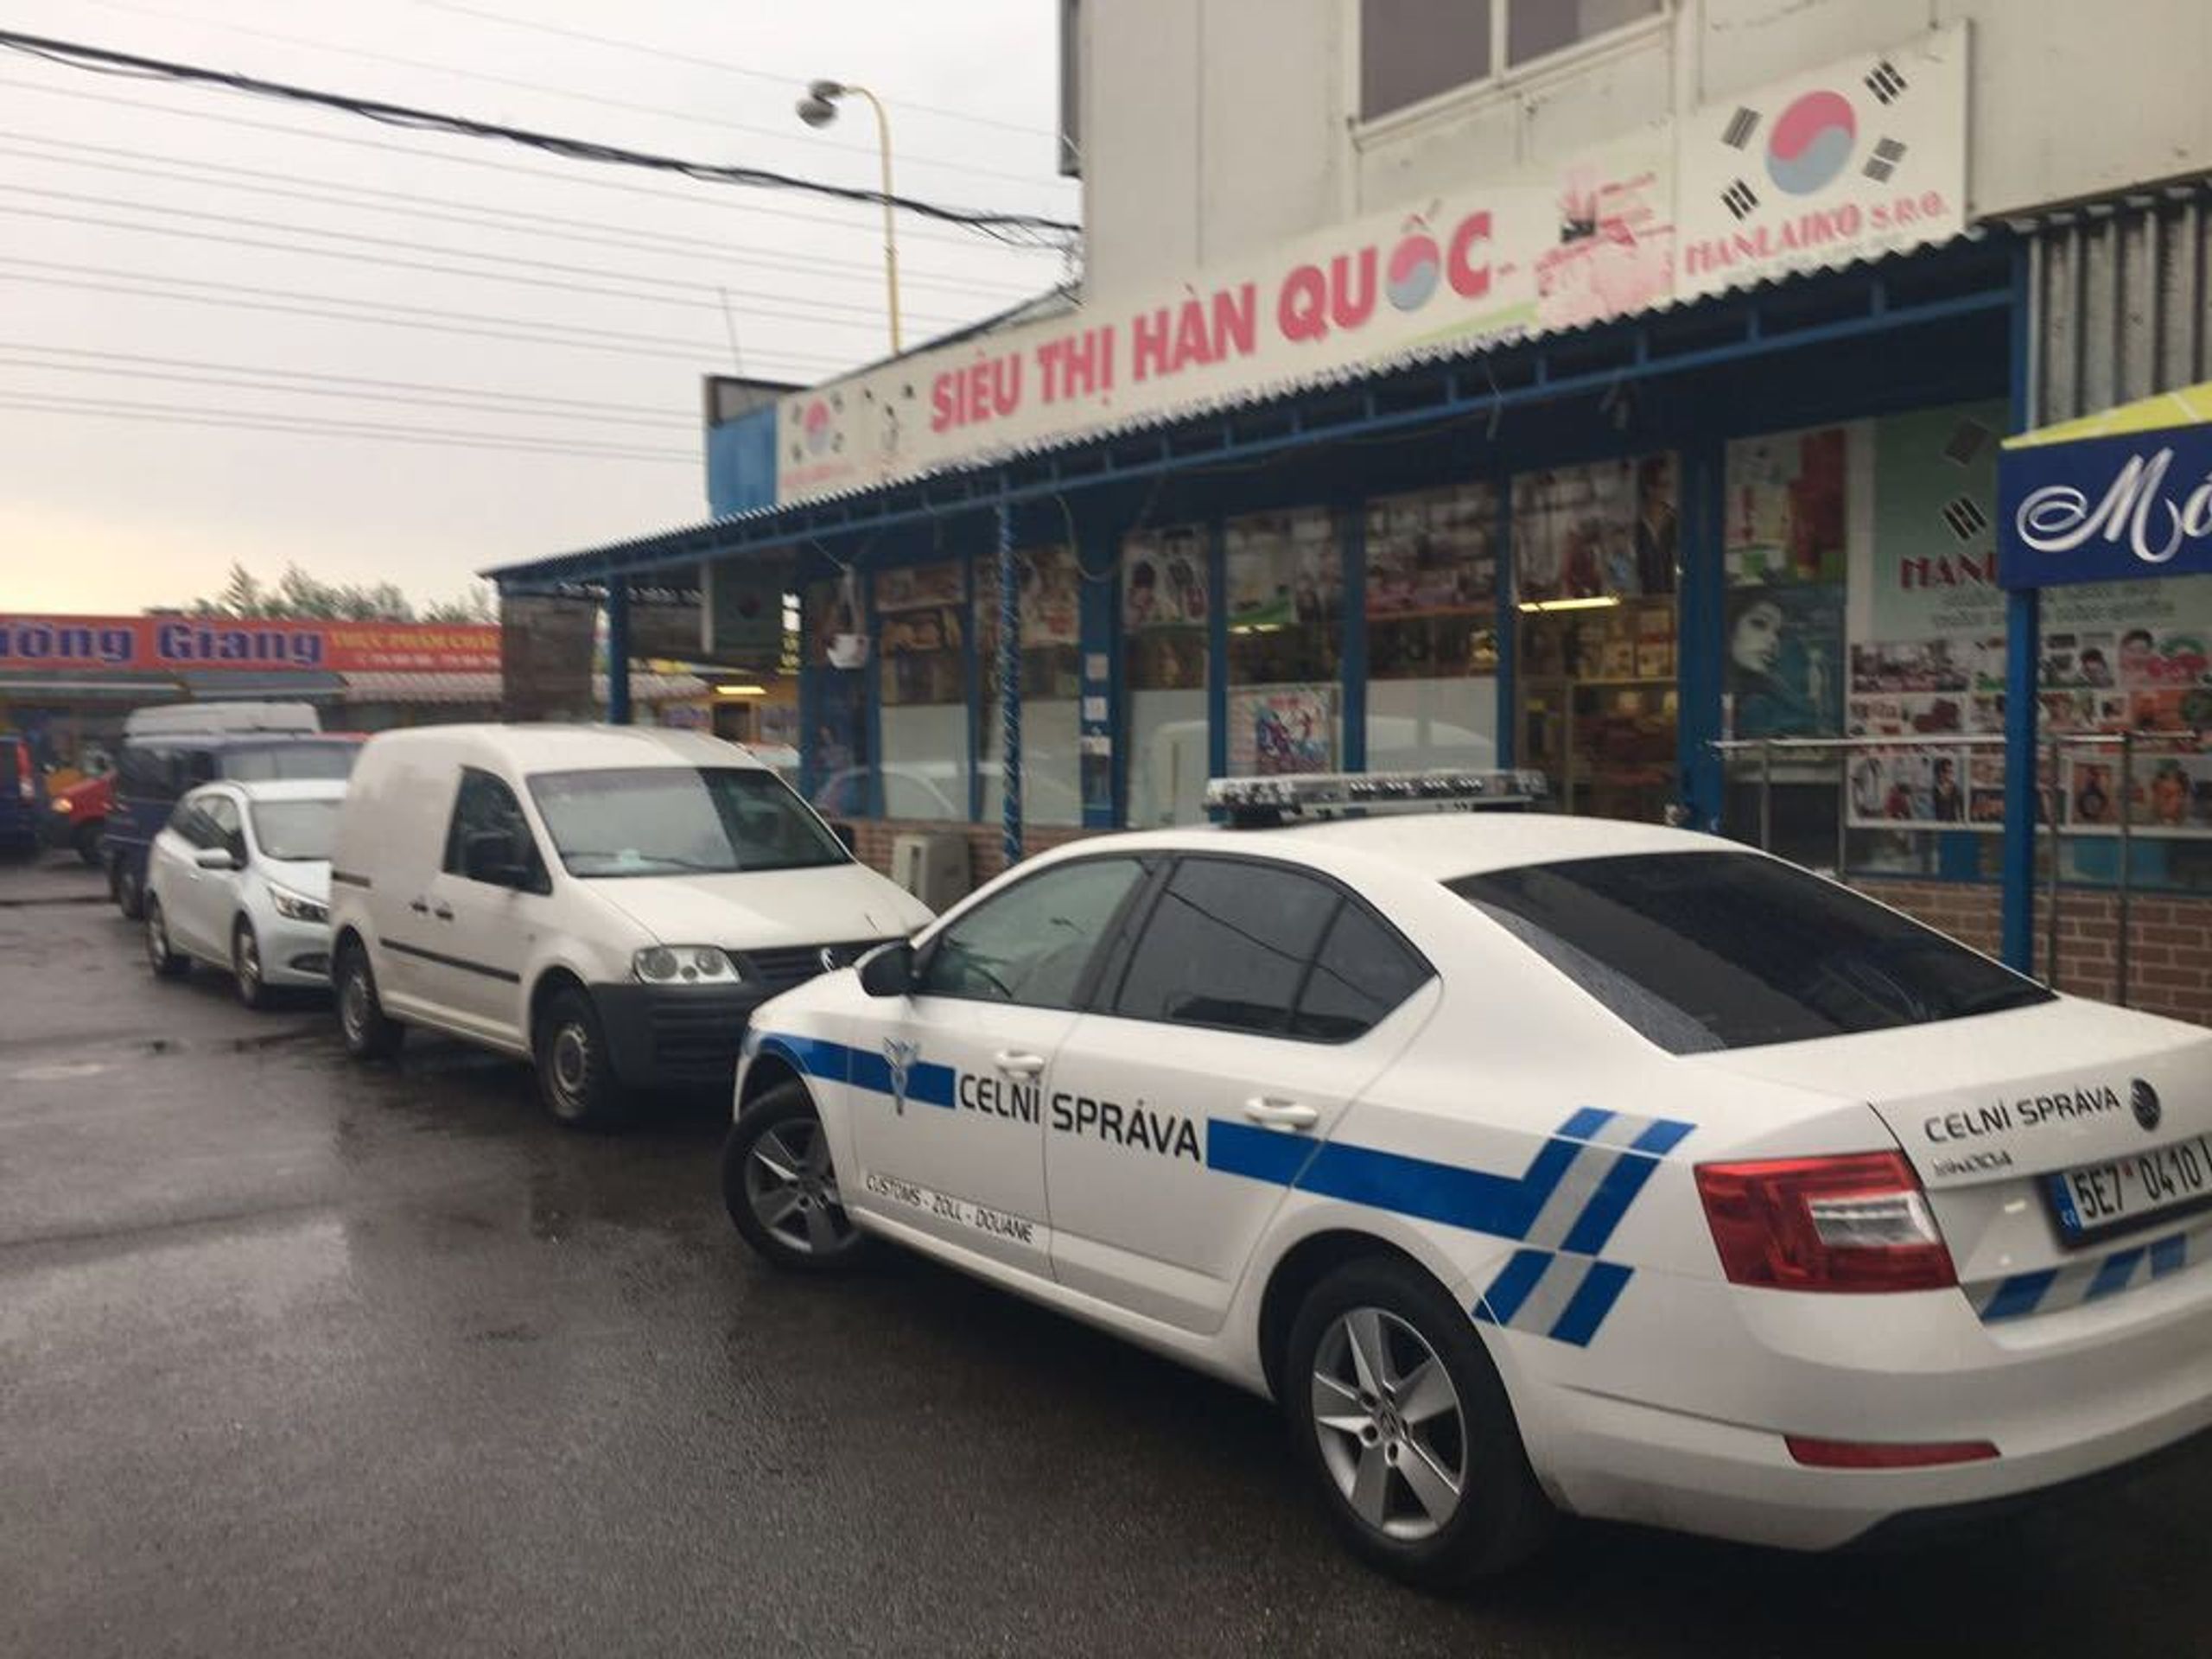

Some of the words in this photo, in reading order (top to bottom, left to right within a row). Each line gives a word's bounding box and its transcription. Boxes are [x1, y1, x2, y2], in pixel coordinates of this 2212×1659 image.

[1038, 324, 1116, 406] THỊ
[1132, 283, 1257, 382] HÀN
[158, 622, 322, 666] Giang
[1051, 1091, 1201, 1162] SPRÁVA
[1923, 1098, 2012, 1143] CELNÍ
[2016, 1085, 2121, 1126] SPRÁVA
[2071, 1166, 2123, 1219] 5E7
[2138, 1145, 2202, 1201] 0410
[975, 1209, 1034, 1244] DOUANE
